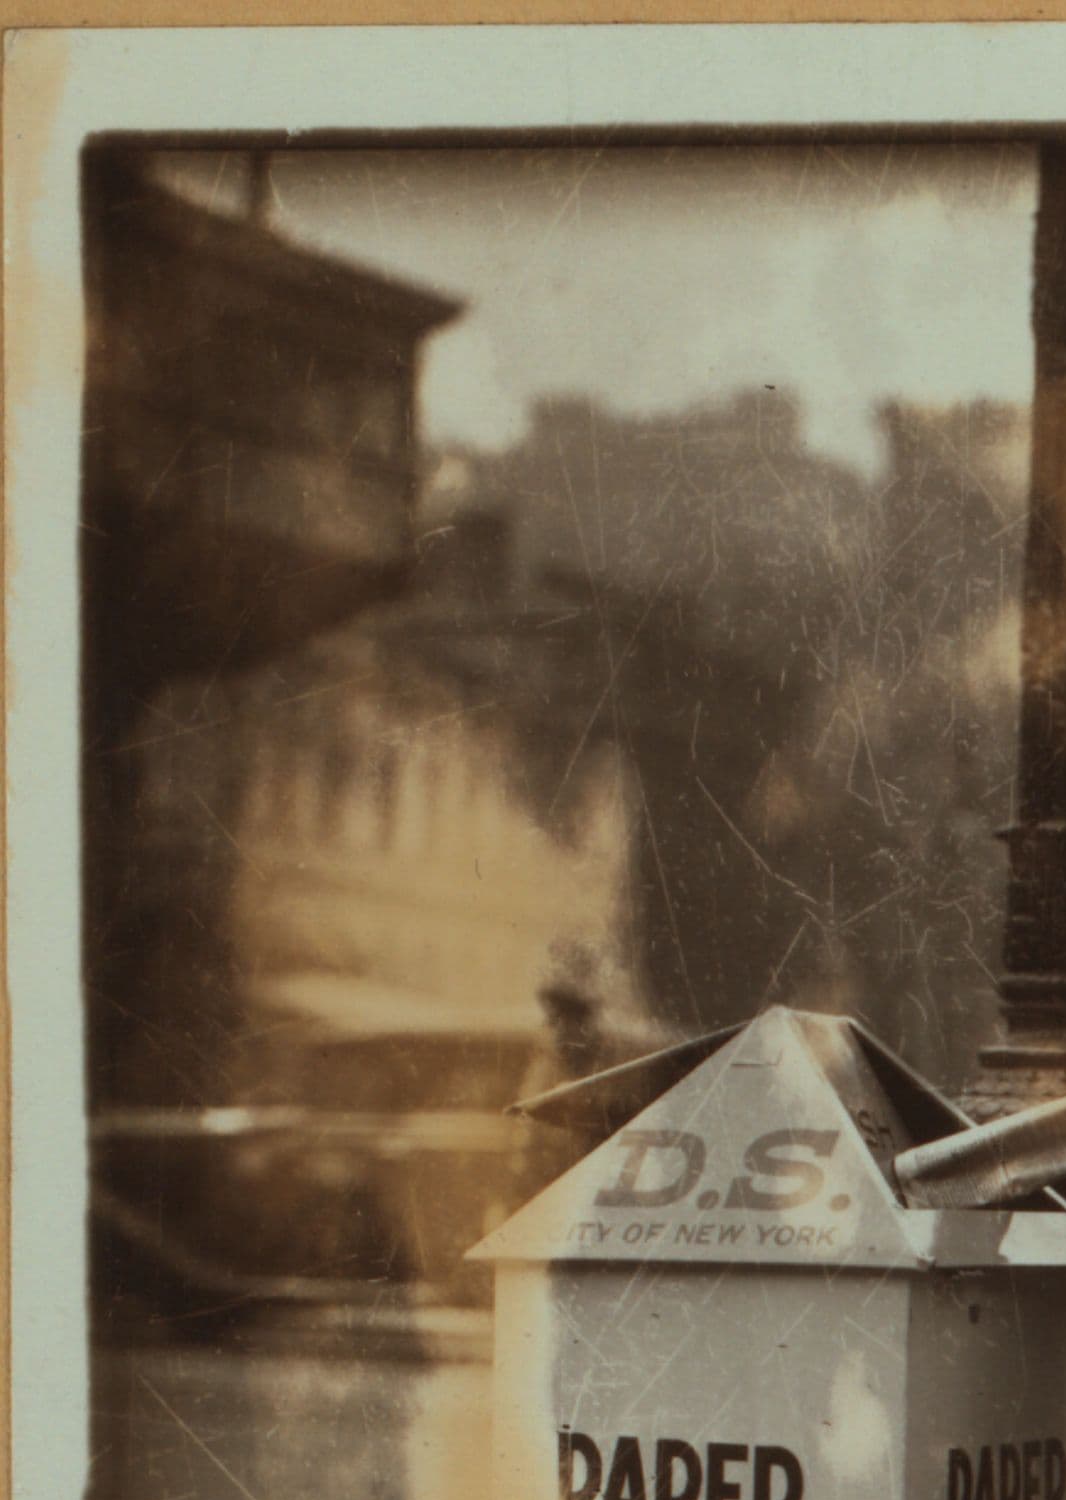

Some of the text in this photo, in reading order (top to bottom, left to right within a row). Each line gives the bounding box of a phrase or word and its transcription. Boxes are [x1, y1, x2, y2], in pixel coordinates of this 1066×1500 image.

[592, 1127, 852, 1212] D.S.
[553, 1221, 838, 1247] ITY OF NEW YORK
